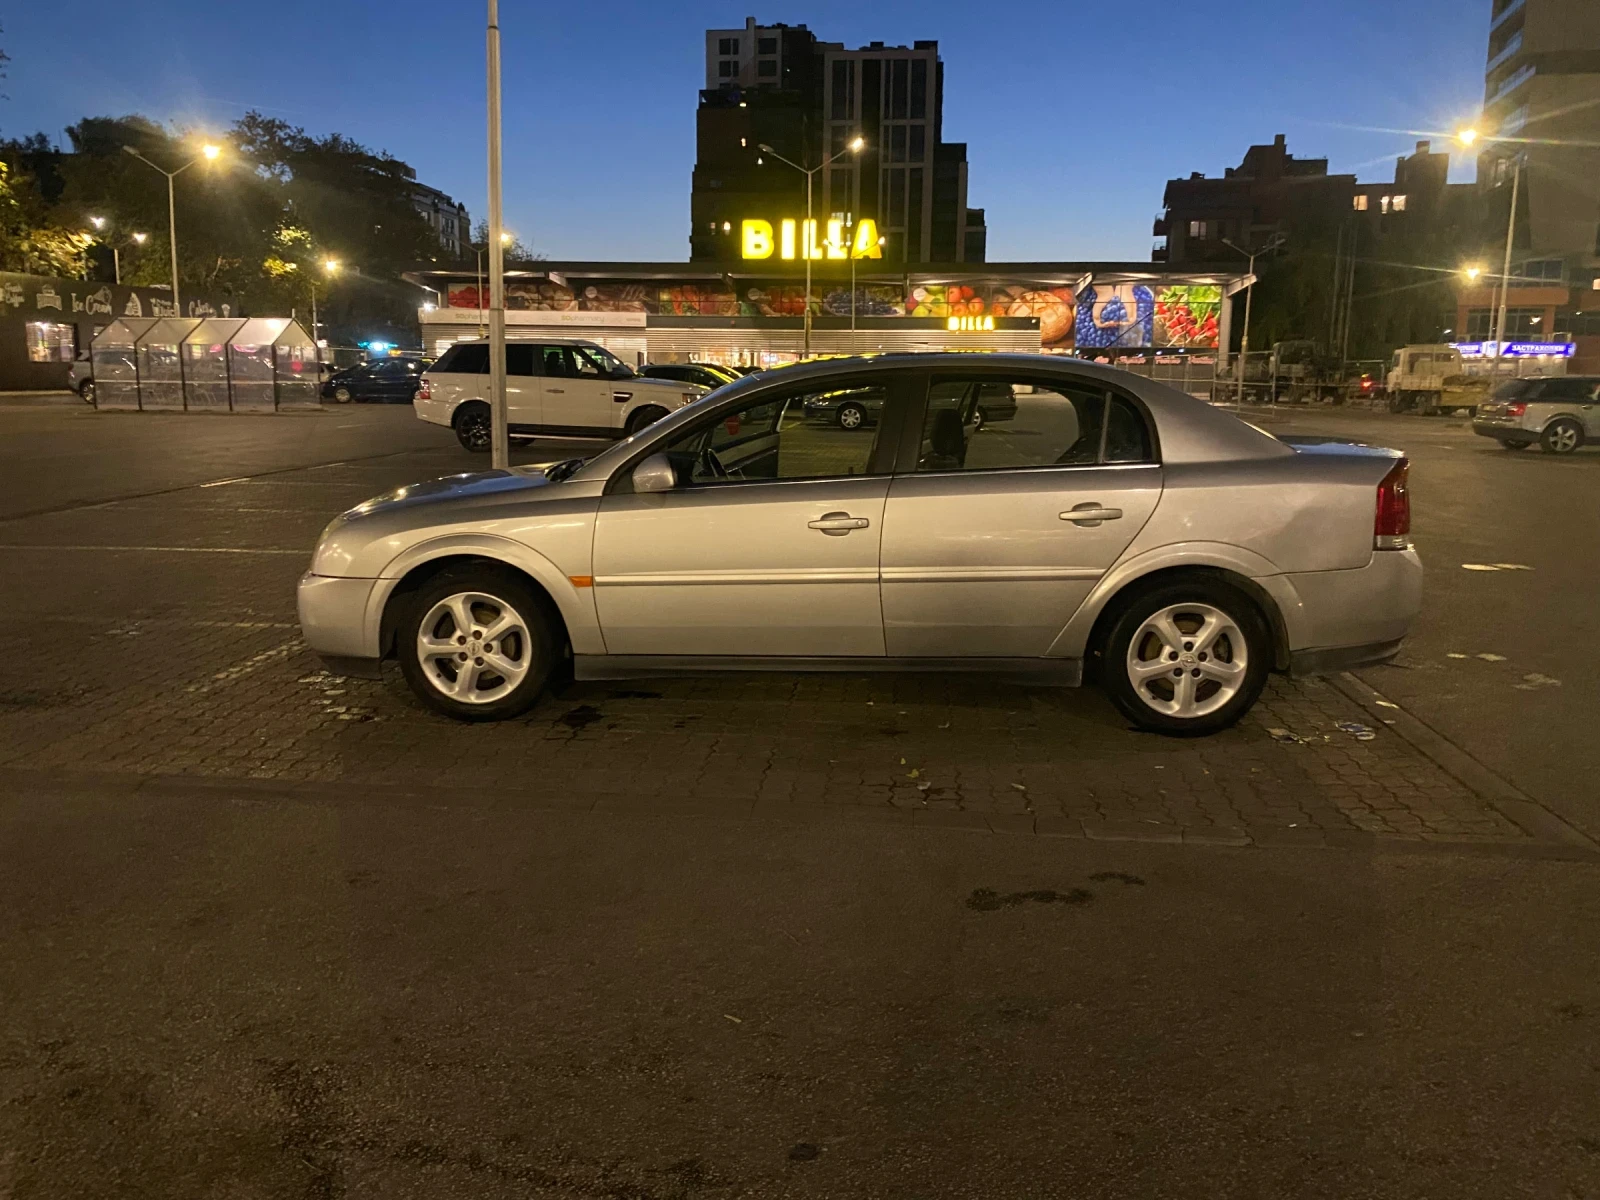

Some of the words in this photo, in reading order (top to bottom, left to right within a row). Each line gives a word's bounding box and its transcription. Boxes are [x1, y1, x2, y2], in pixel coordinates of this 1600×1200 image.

[741, 218, 883, 260] BILLA
[70, 292, 84, 313] Ice
[85, 294, 113, 316] Cream
[946, 316, 995, 331] BILLA
